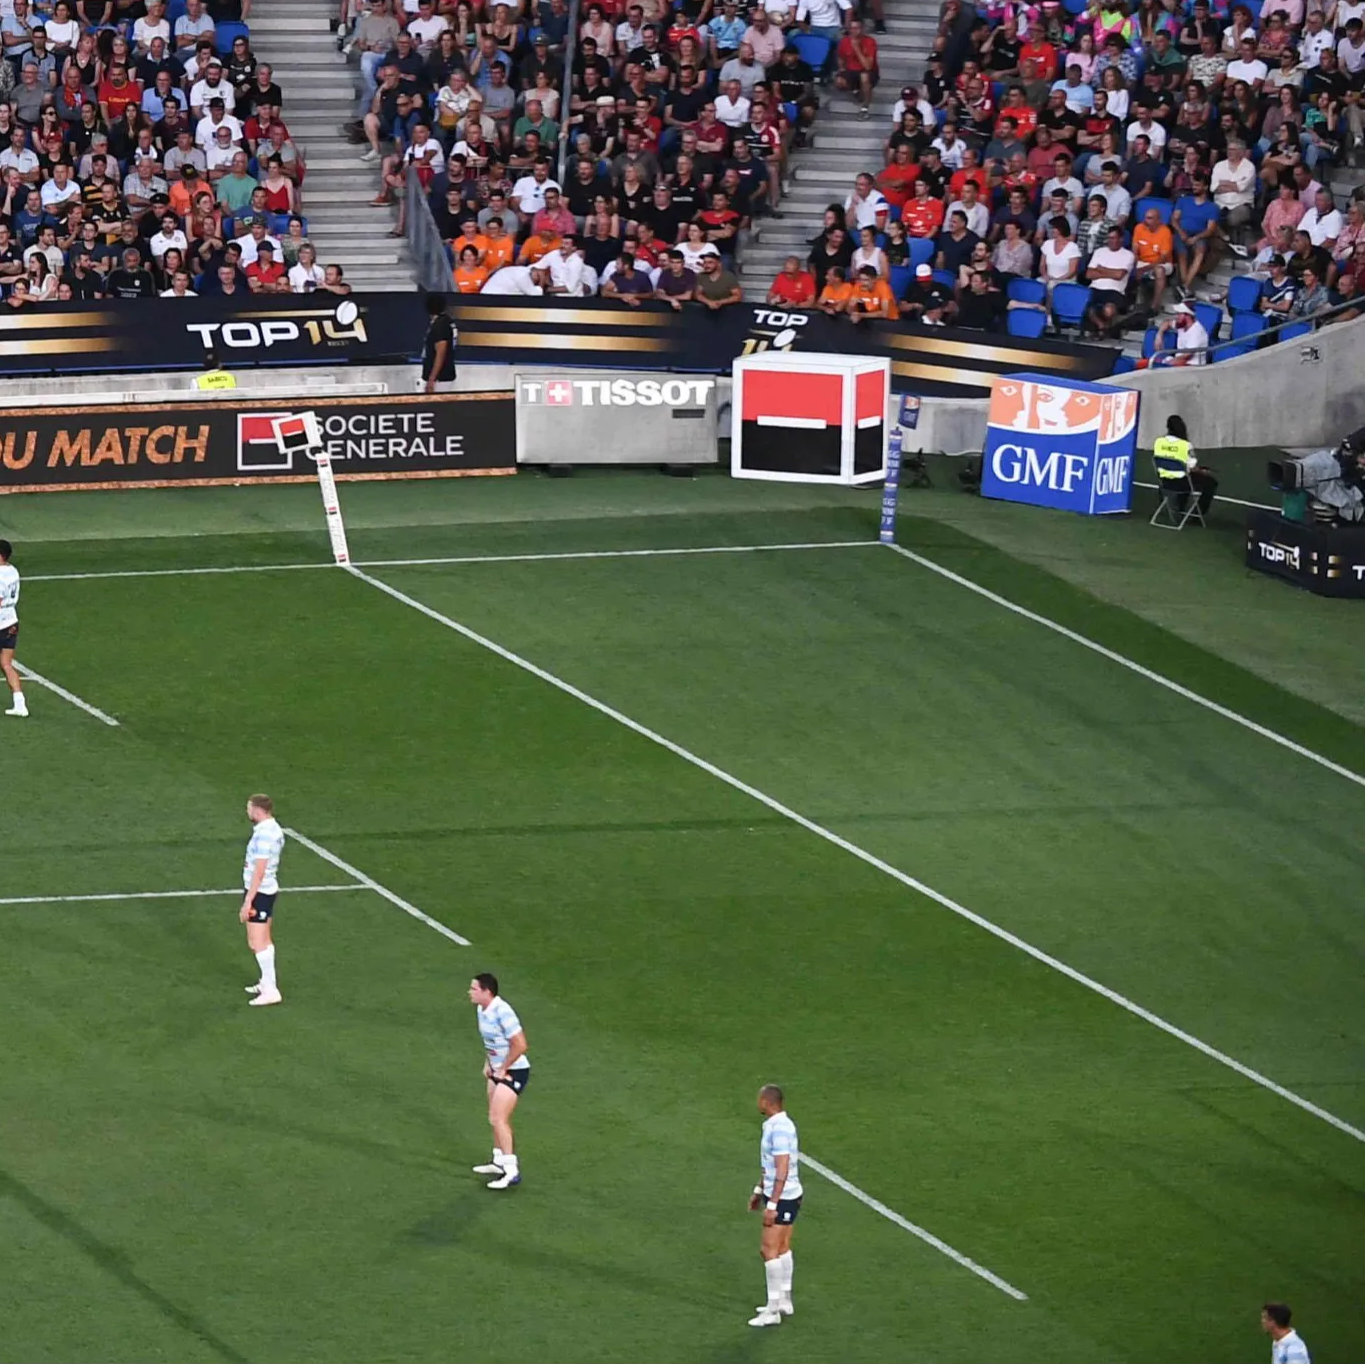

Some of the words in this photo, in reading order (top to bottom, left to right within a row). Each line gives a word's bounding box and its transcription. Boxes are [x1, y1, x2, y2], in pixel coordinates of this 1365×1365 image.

[754, 309, 809, 327] TOP
[572, 379, 716, 406] TISSOT
[46, 424, 210, 468] MATCH
[991, 443, 1089, 492] GMF
[1096, 455, 1130, 496] GMF
